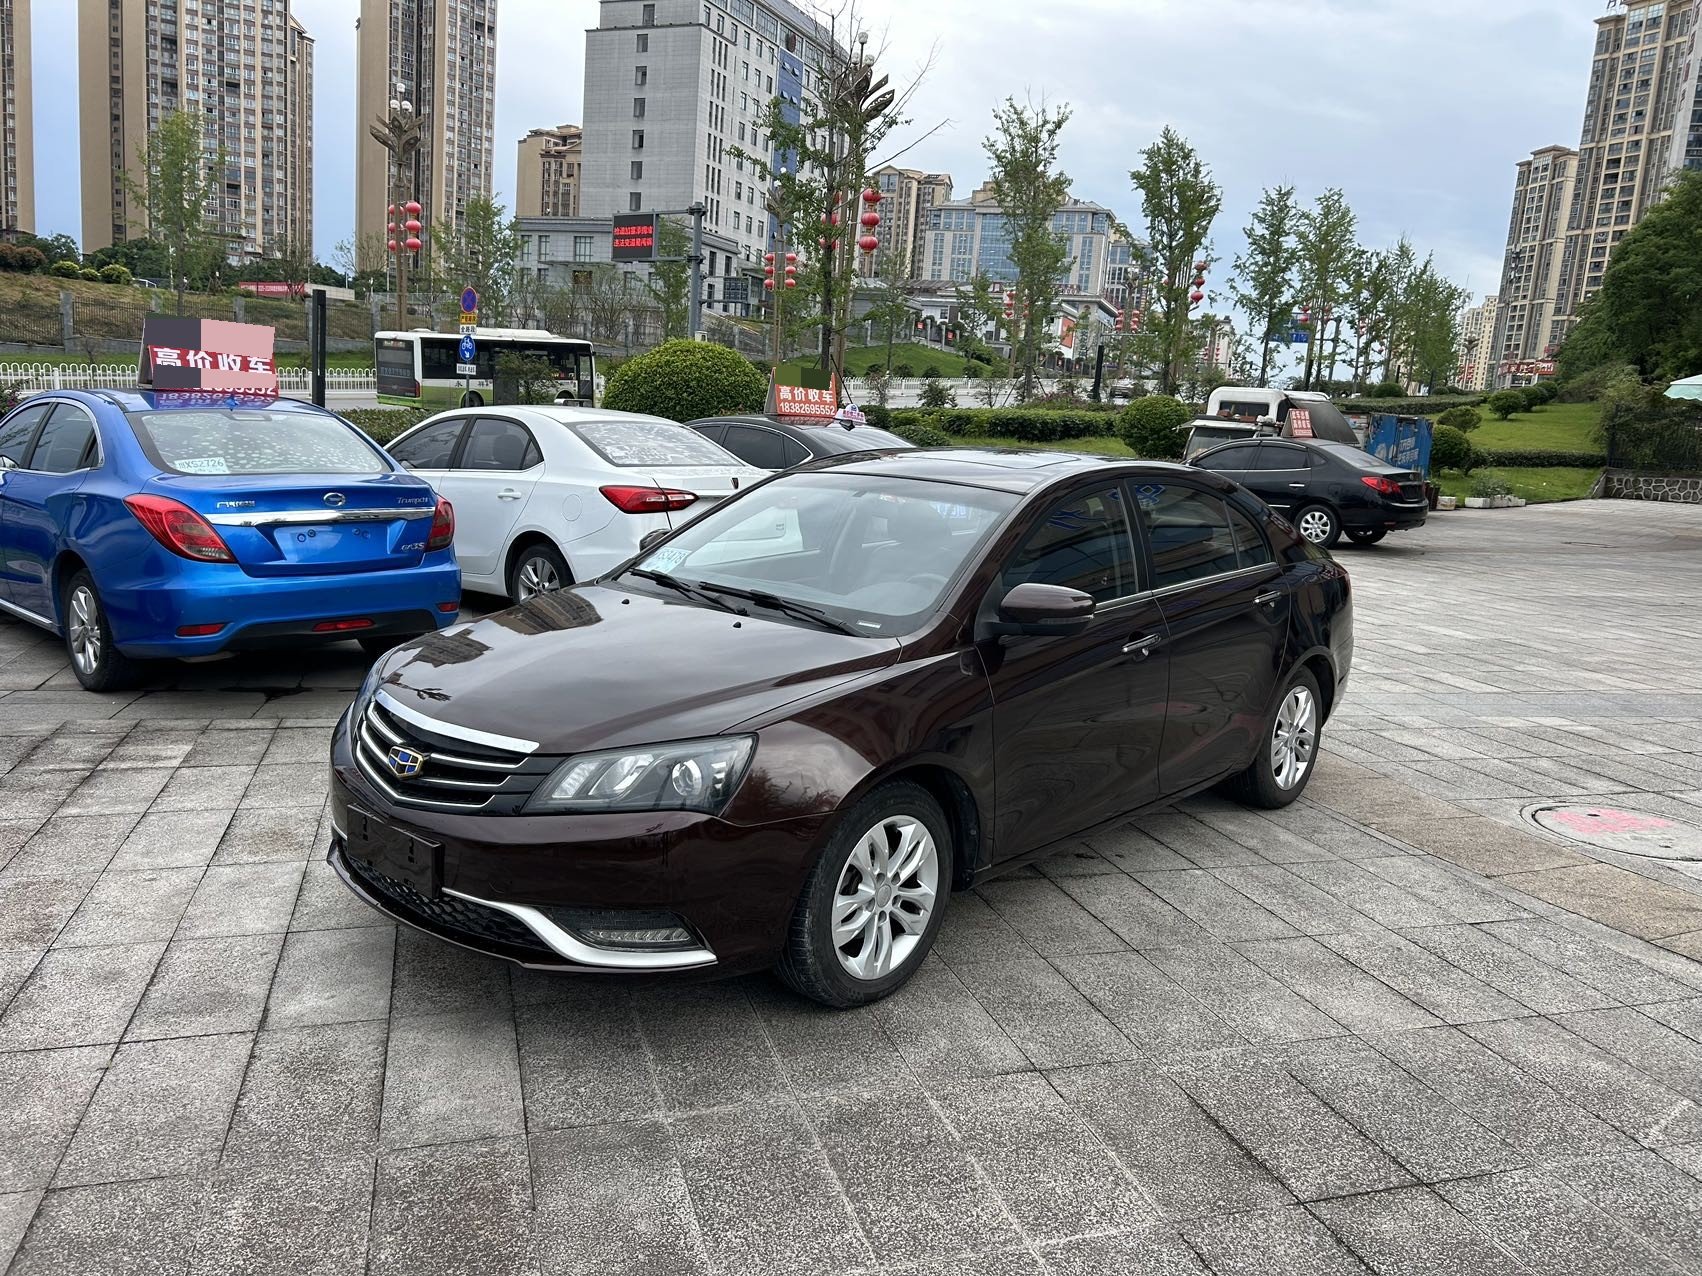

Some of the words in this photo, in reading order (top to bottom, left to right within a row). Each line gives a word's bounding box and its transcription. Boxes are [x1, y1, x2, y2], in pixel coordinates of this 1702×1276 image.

[153, 347, 273, 375] 高价收车
[779, 385, 834, 403] 高价收车
[780, 401, 836, 416] 18382695552
